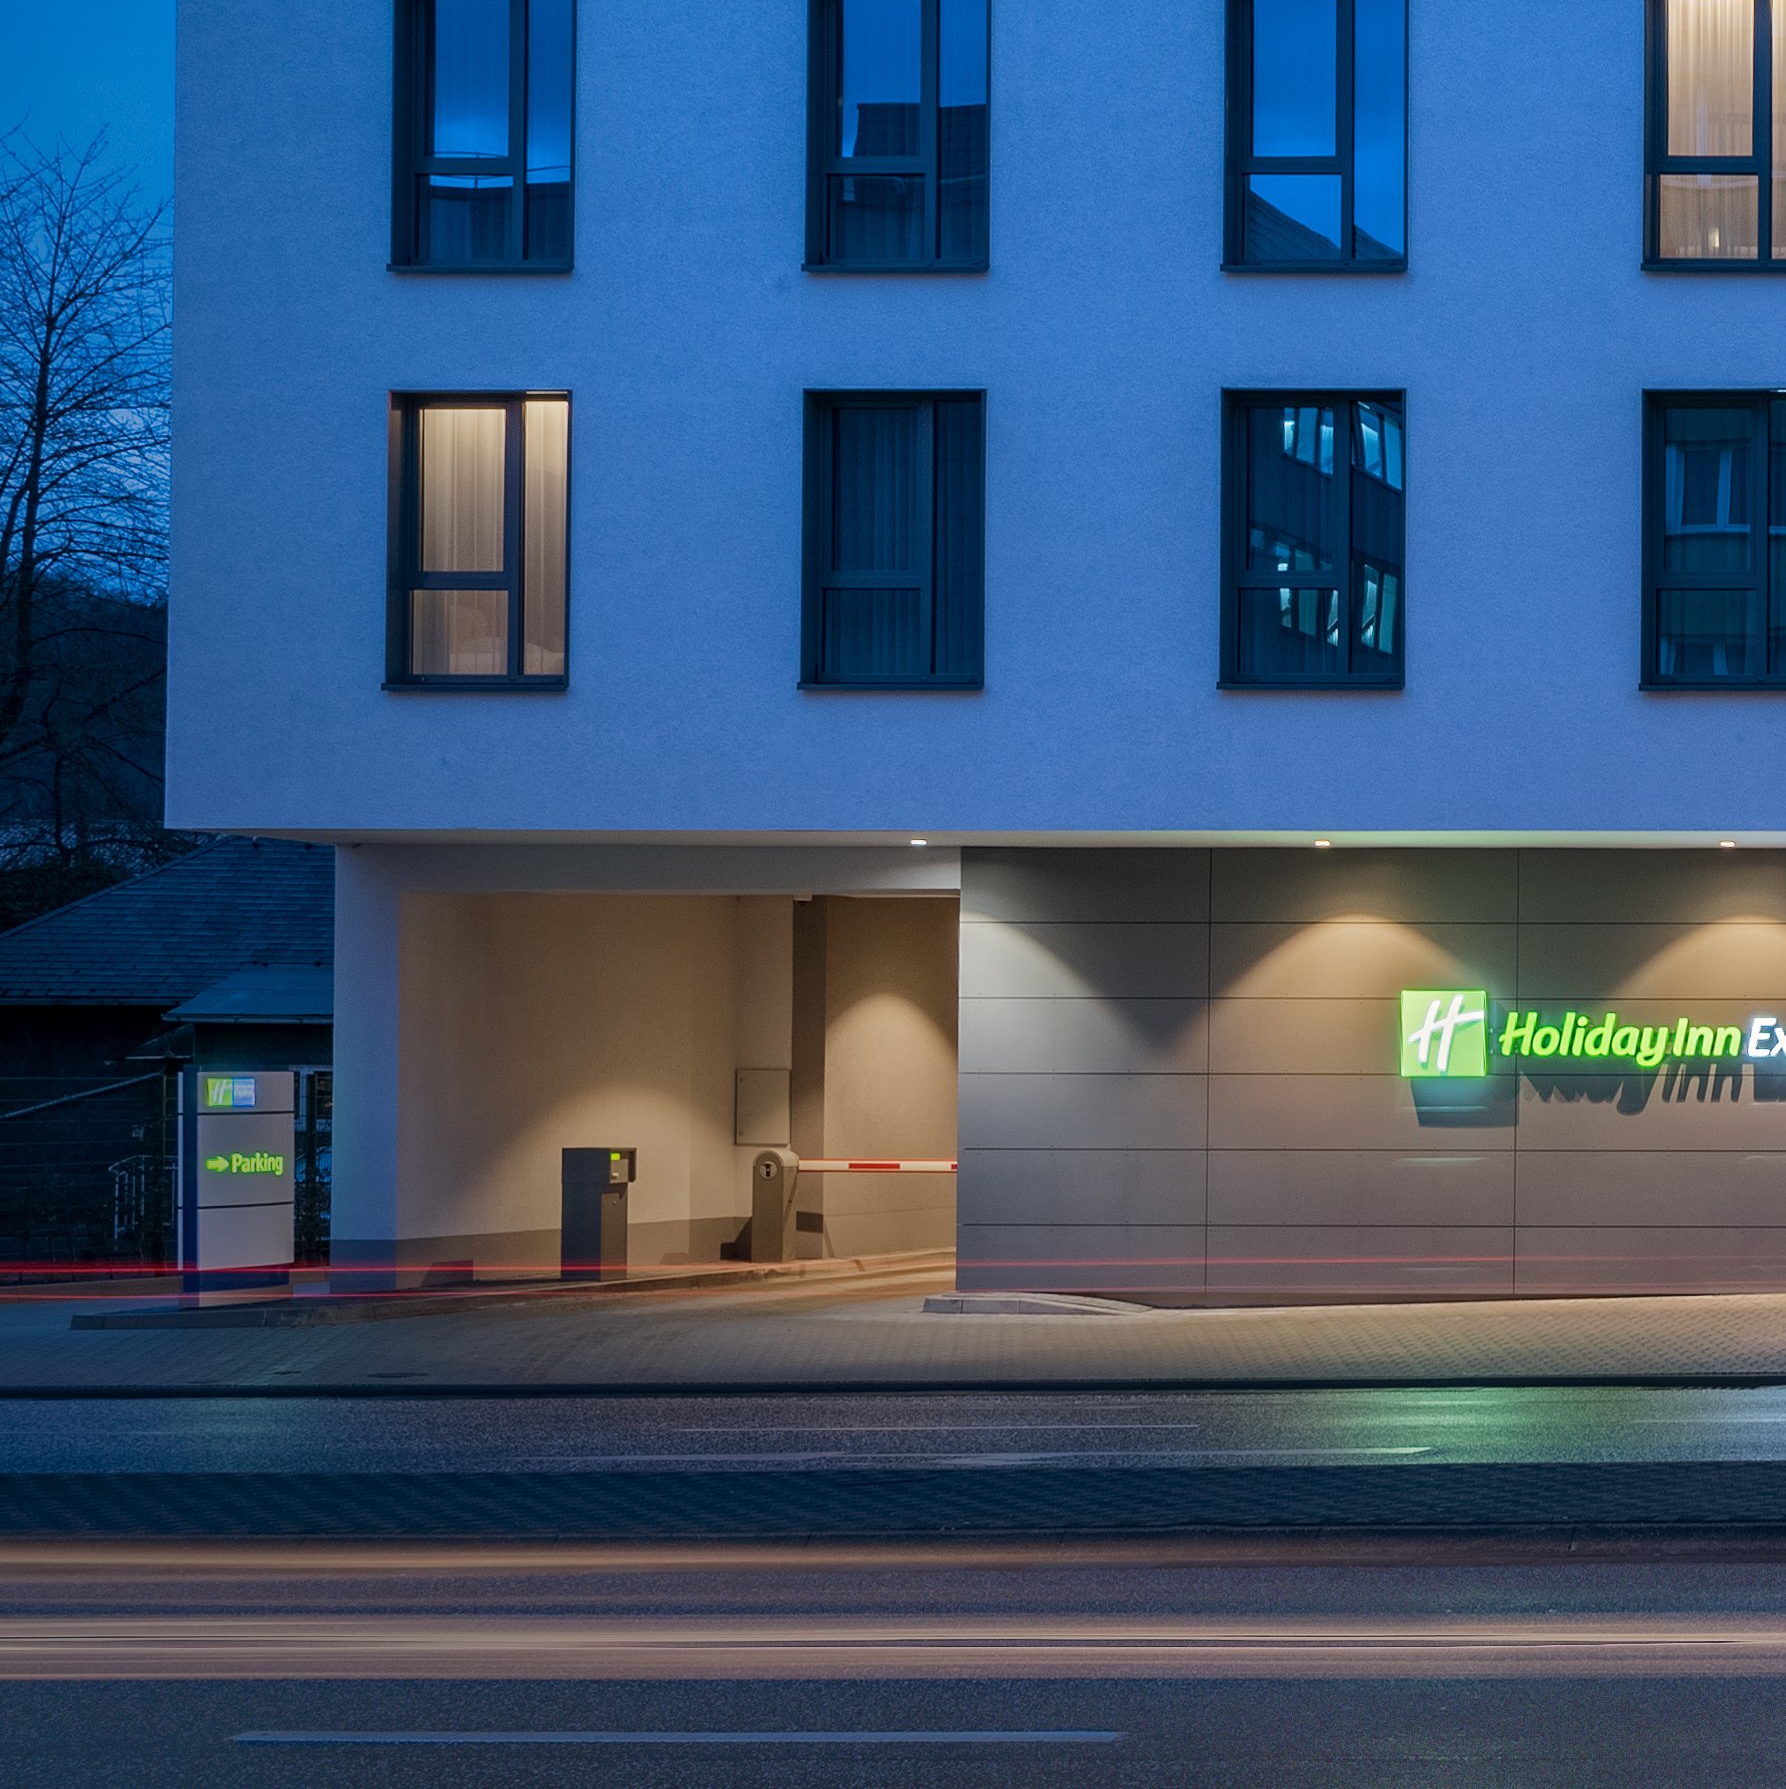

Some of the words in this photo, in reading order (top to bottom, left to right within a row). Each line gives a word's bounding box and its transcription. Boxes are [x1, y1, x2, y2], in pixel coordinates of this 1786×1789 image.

[1499, 1011, 1669, 1068] Holiday
[1672, 1017, 1742, 1057] Inn
[231, 1152, 284, 1176] Parking
